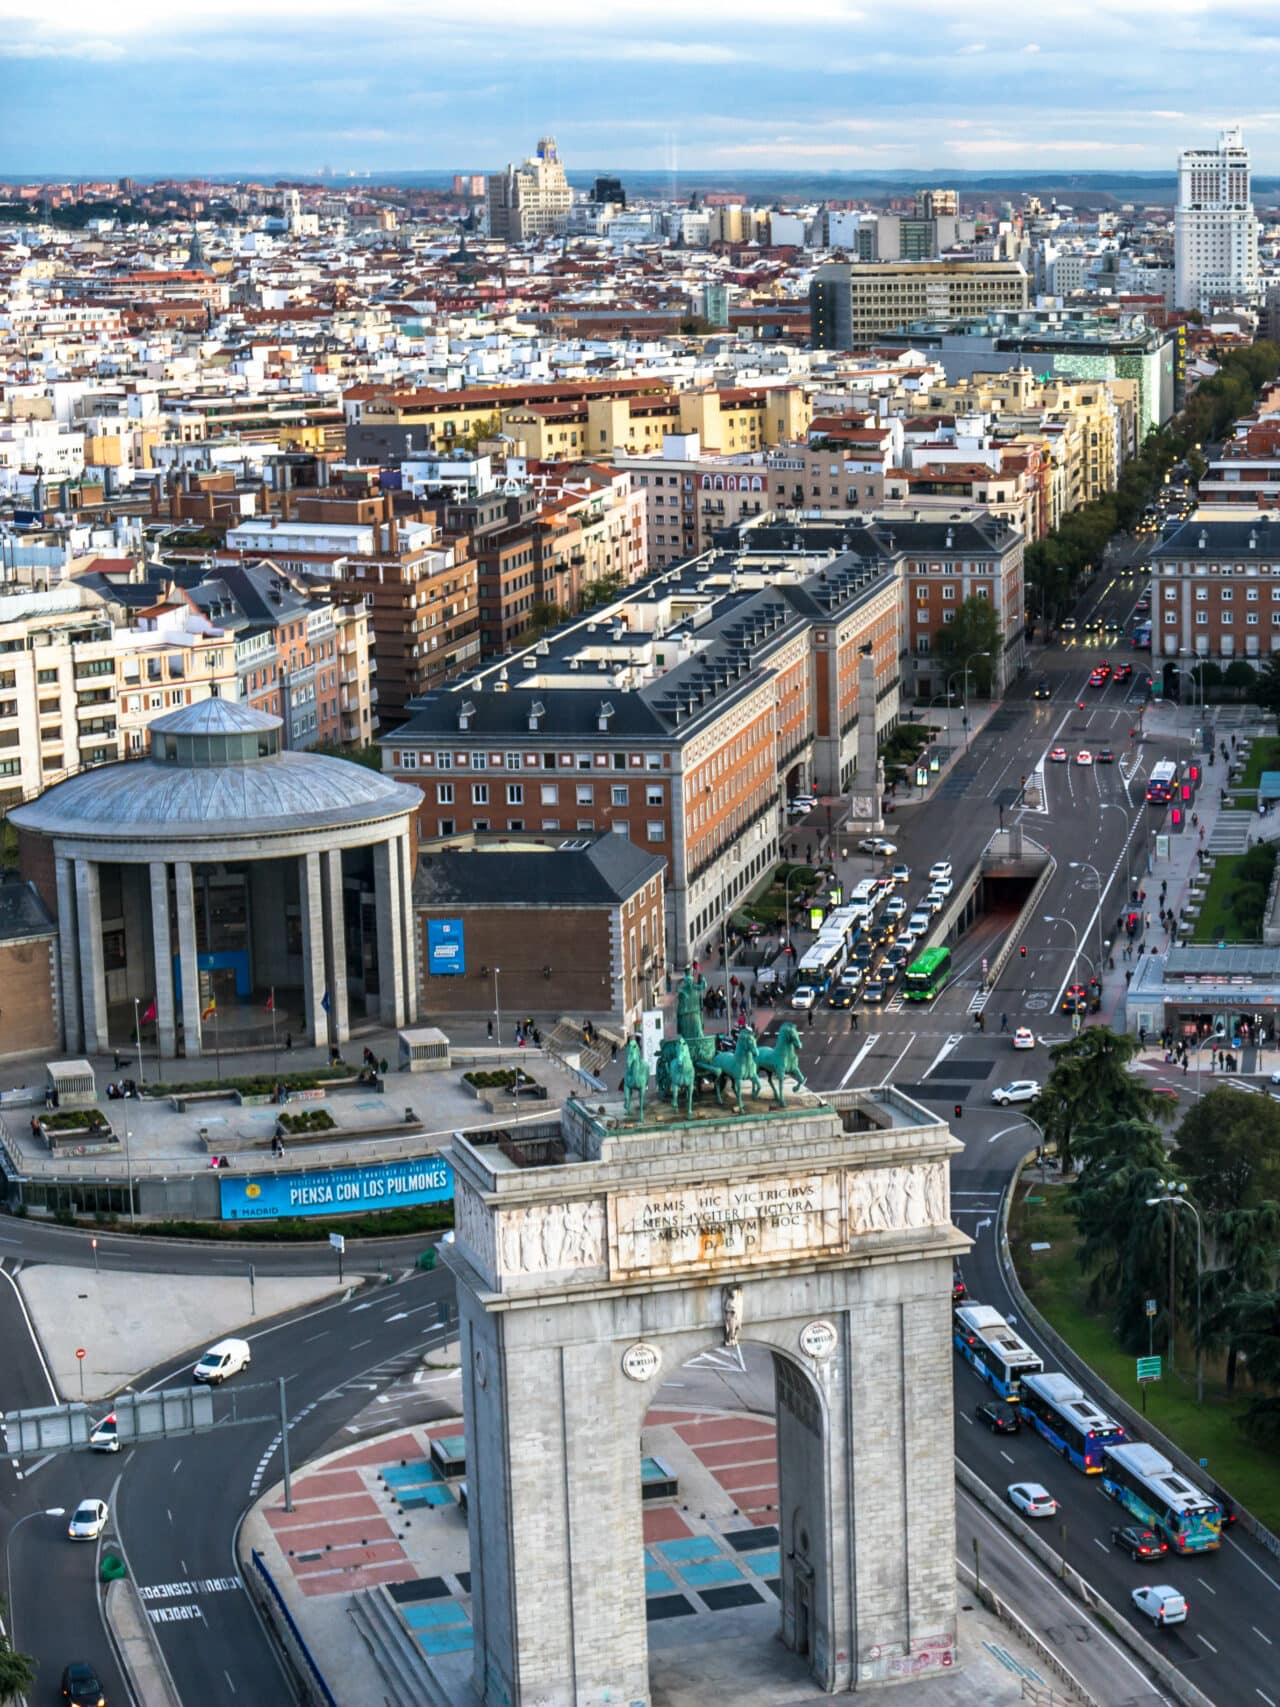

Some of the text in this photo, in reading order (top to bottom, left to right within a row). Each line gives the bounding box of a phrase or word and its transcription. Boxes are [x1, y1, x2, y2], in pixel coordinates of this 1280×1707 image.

[1177, 325, 1186, 380] HOTEL
[290, 1170, 448, 1206] PIENSA CON LOS PULMONES
[242, 1206, 279, 1216] MADRID
[643, 1199, 686, 1215] ARMIS
[700, 1196, 721, 1209] HIC
[642, 1214, 678, 1229] MENS
[771, 1215, 800, 1229] HOC
[148, 1605, 201, 1623] CARDENAL
